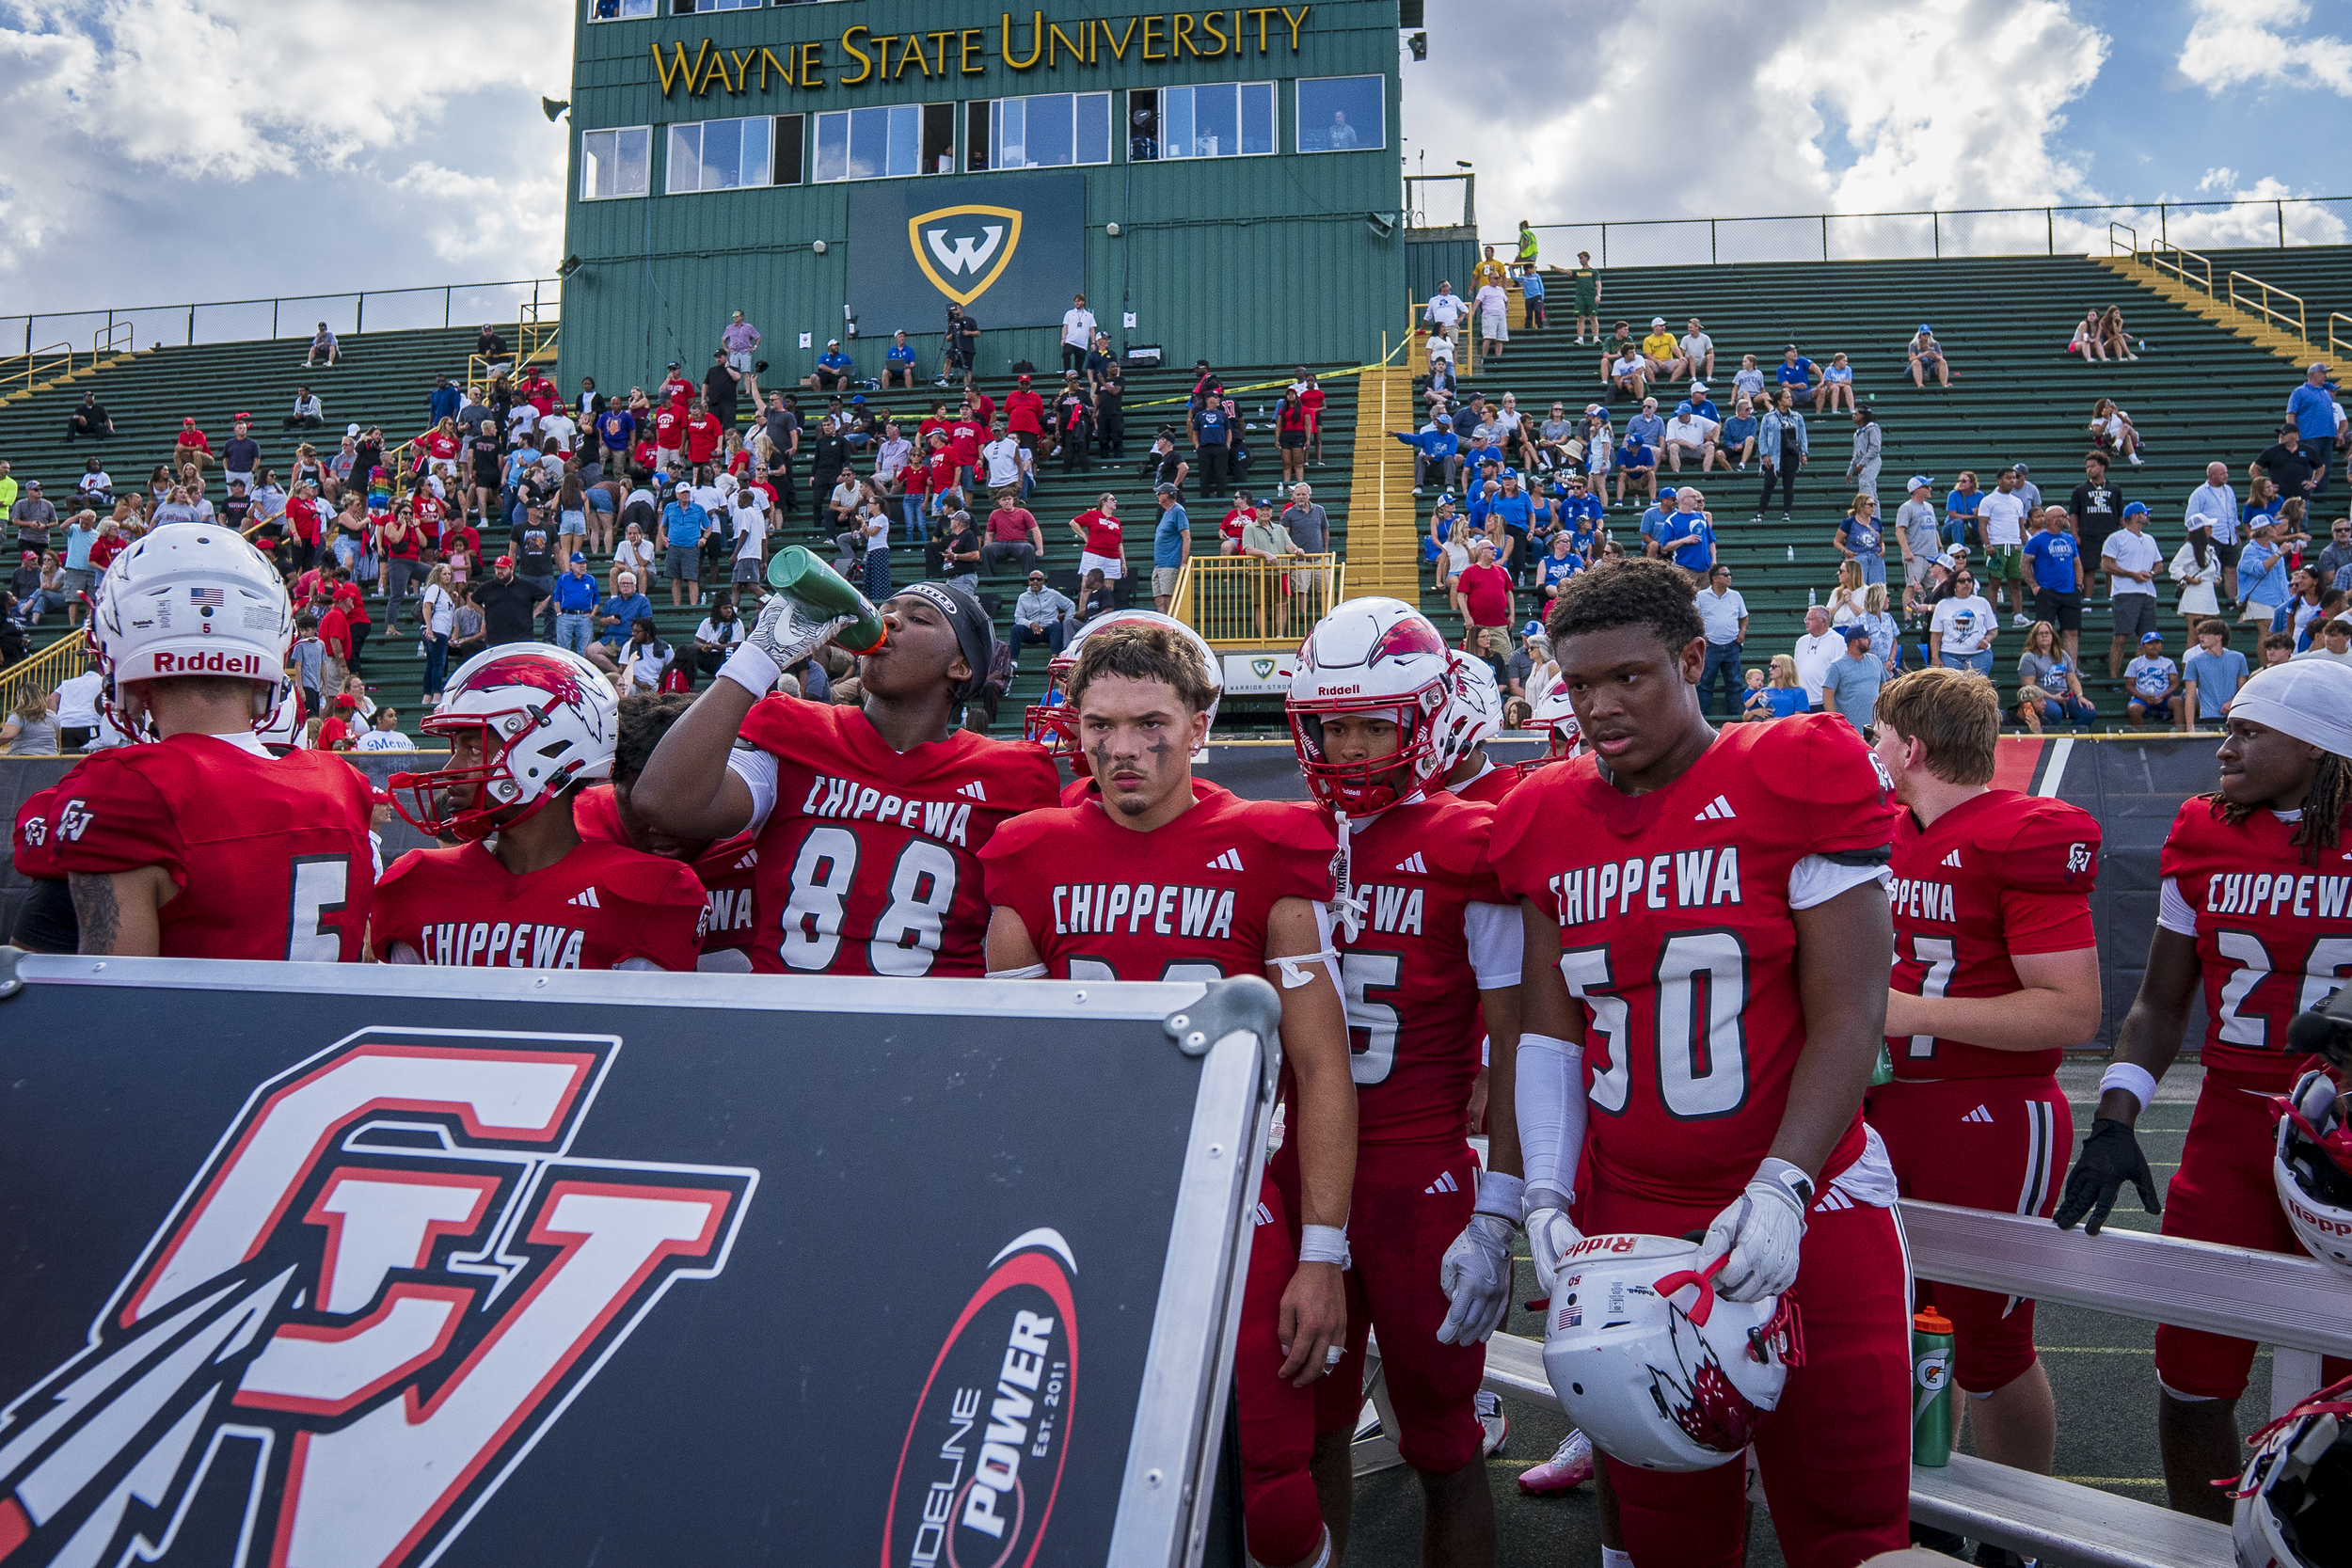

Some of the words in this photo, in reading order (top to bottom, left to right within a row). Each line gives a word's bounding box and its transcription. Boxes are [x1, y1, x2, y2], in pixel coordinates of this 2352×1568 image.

[650, 39, 825, 96] WAYNE
[840, 25, 984, 86] STATE
[1002, 6, 1310, 69] UNIVERSITY
[927, 225, 1003, 276] W
[1221, 400, 1235, 419] 17
[202, 623, 211, 634] 5
[153, 652, 260, 674] Riddell
[1318, 684, 1360, 696] Riddell
[802, 774, 973, 847] CHIPPEWA
[1343, 786, 1361, 797] iddell
[1335, 858, 1347, 894] NXTRND
[1549, 845, 1743, 928] CHIPPEWA
[2206, 873, 2352, 918] CHIPPEW
[778, 824, 961, 977] 88
[1052, 882, 1236, 940] CHIPPEWA
[1889, 876, 1957, 924] PPEWA
[421, 921, 586, 970] CHIPPEWA
[1558, 927, 1750, 1120] 50
[2288, 1197, 2352, 1237] ddell
[1557, 1237, 1636, 1264] Riddel
[1568, 1275, 1582, 1288] 50
[1627, 1288, 1655, 1297] Riddell
[1916, 1357, 1947, 1391] G
[961, 1309, 1055, 1539] POWER
[1031, 1415, 1056, 1458] EST.
[1044, 1361, 1067, 1407] 2011
[909, 1386, 981, 1568] IDELINE
